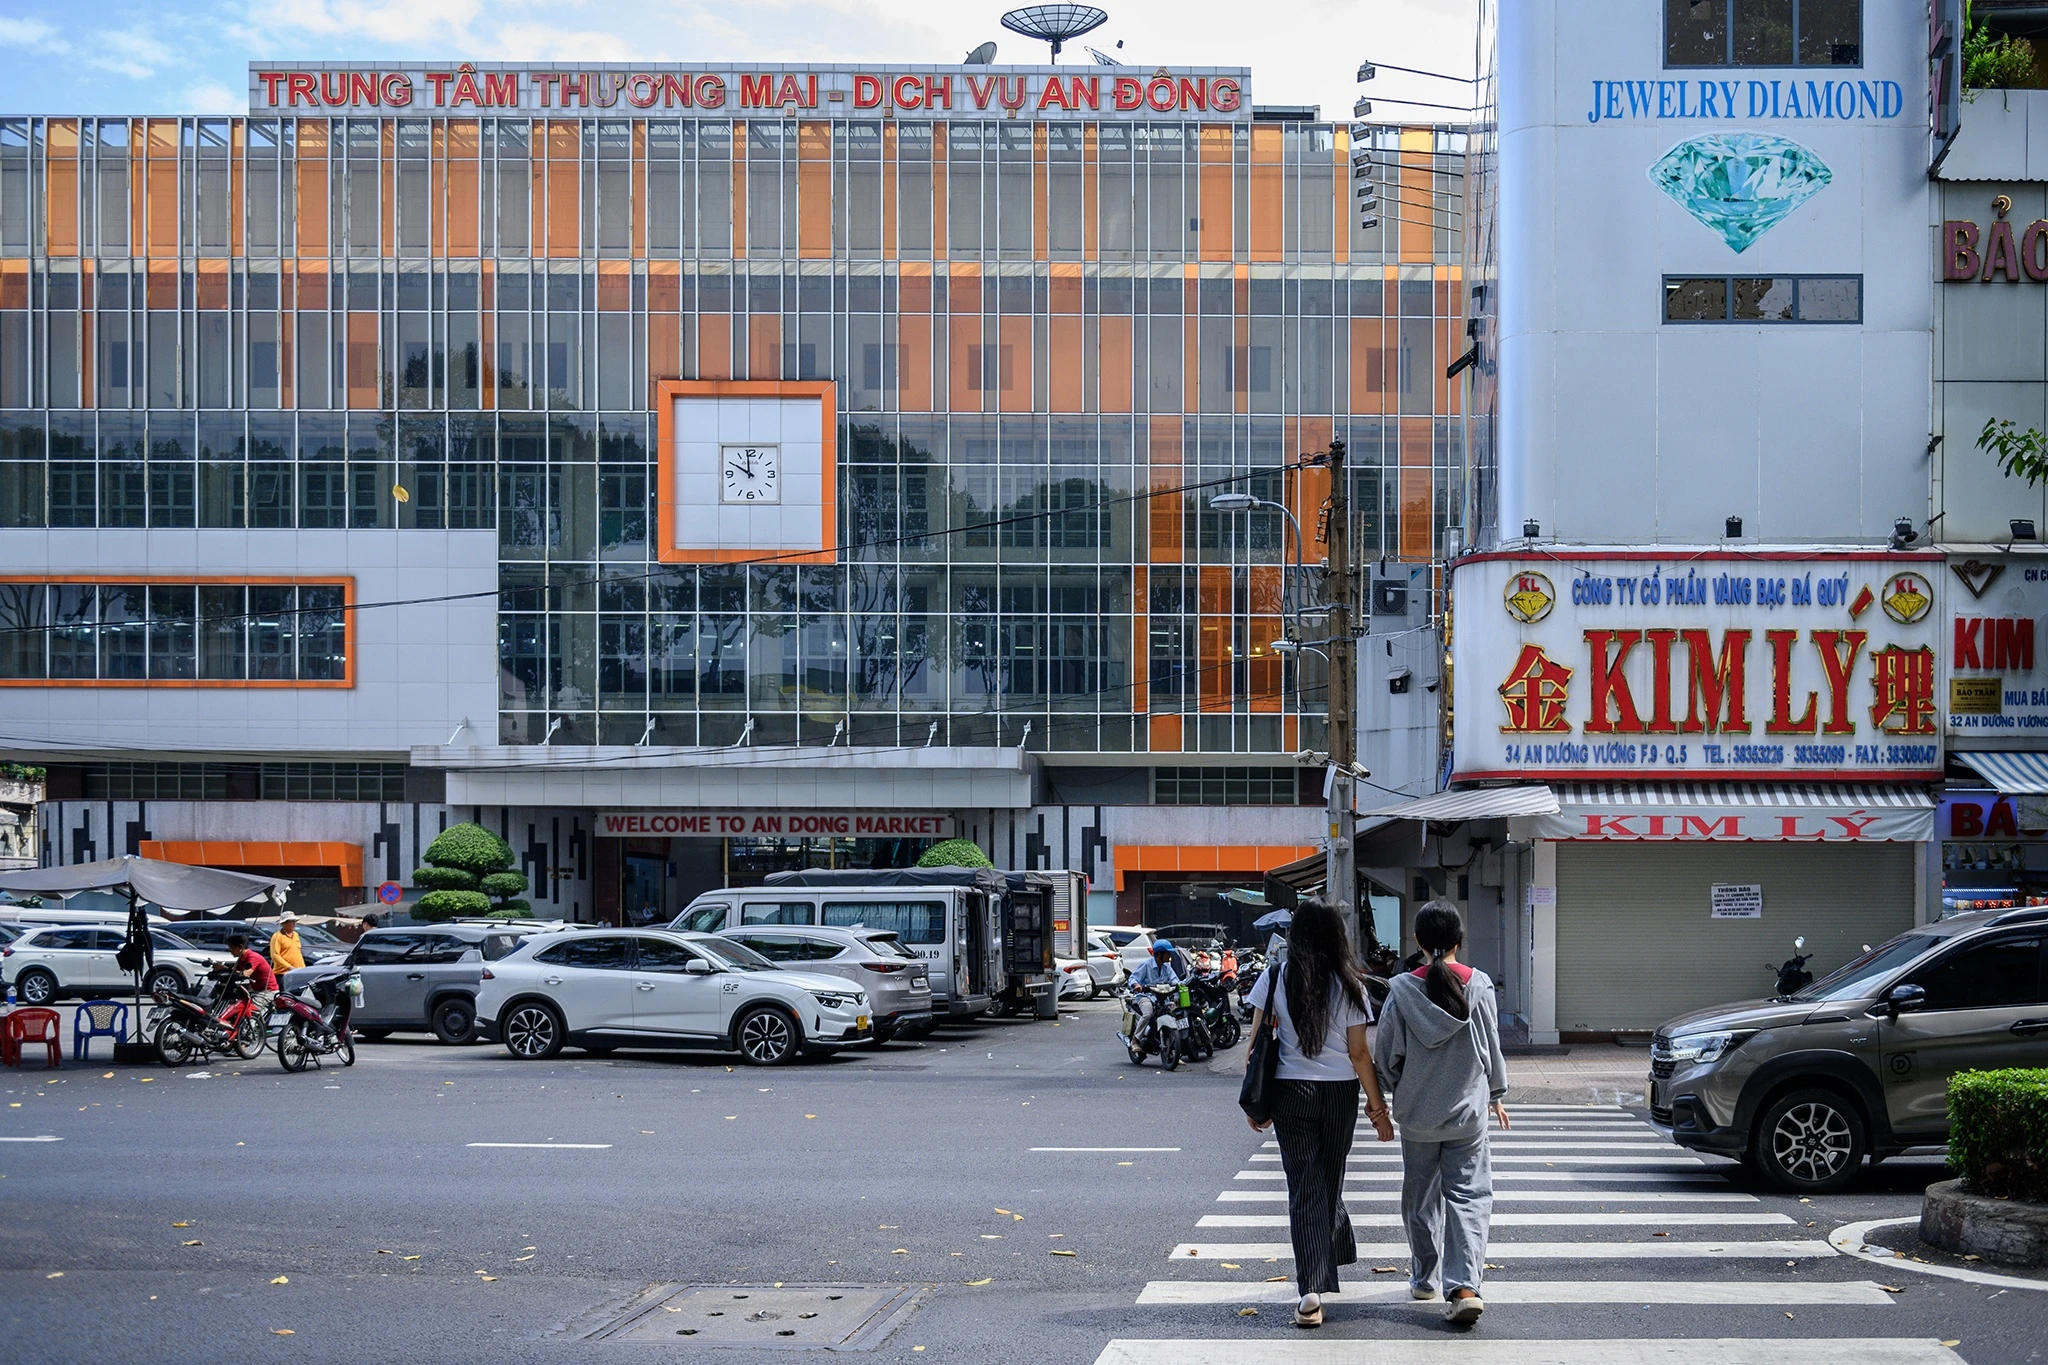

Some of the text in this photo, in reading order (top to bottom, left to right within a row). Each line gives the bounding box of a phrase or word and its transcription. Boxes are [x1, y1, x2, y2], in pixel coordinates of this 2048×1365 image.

[258, 71, 412, 107] TRUNG
[424, 62, 518, 108] TÂM
[531, 72, 726, 108] THƯƠNG
[741, 74, 818, 116] MẠI
[852, 75, 952, 116] DỊCH
[965, 75, 1026, 118] VỤ
[1037, 75, 1100, 110] AN
[1112, 66, 1241, 111] ĐÔNG
[1587, 79, 1903, 123] JEWELRY DIAMOND
[745, 449, 756, 457] 12
[725, 470, 734, 478] 9
[767, 470, 776, 478] 3
[746, 491, 755, 499] 6
[2024, 569, 2038, 581] CN
[1518, 577, 1540, 592] KL
[1572, 564, 1849, 610] CÔNG TY CỔ PHẦN VÀNG BẠC ĐÁ QUÝ
[1895, 578, 1918, 593] KL
[1954, 617, 2034, 670] KIM
[1583, 583, 1875, 735] KIM LÝ
[1498, 642, 1575, 734] 金
[2004, 691, 2028, 706] MUA
[1950, 716, 1962, 727] 32
[1964, 716, 1978, 727] AN
[1505, 744, 1520, 763] 34
[1524, 744, 1542, 763] AN
[1640, 744, 1657, 763] F.9
[1665, 744, 1688, 764] Q.5
[605, 816, 945, 833] WELCOME TO AN DONG MARKET
[1579, 810, 1884, 837] KIM LÝ
